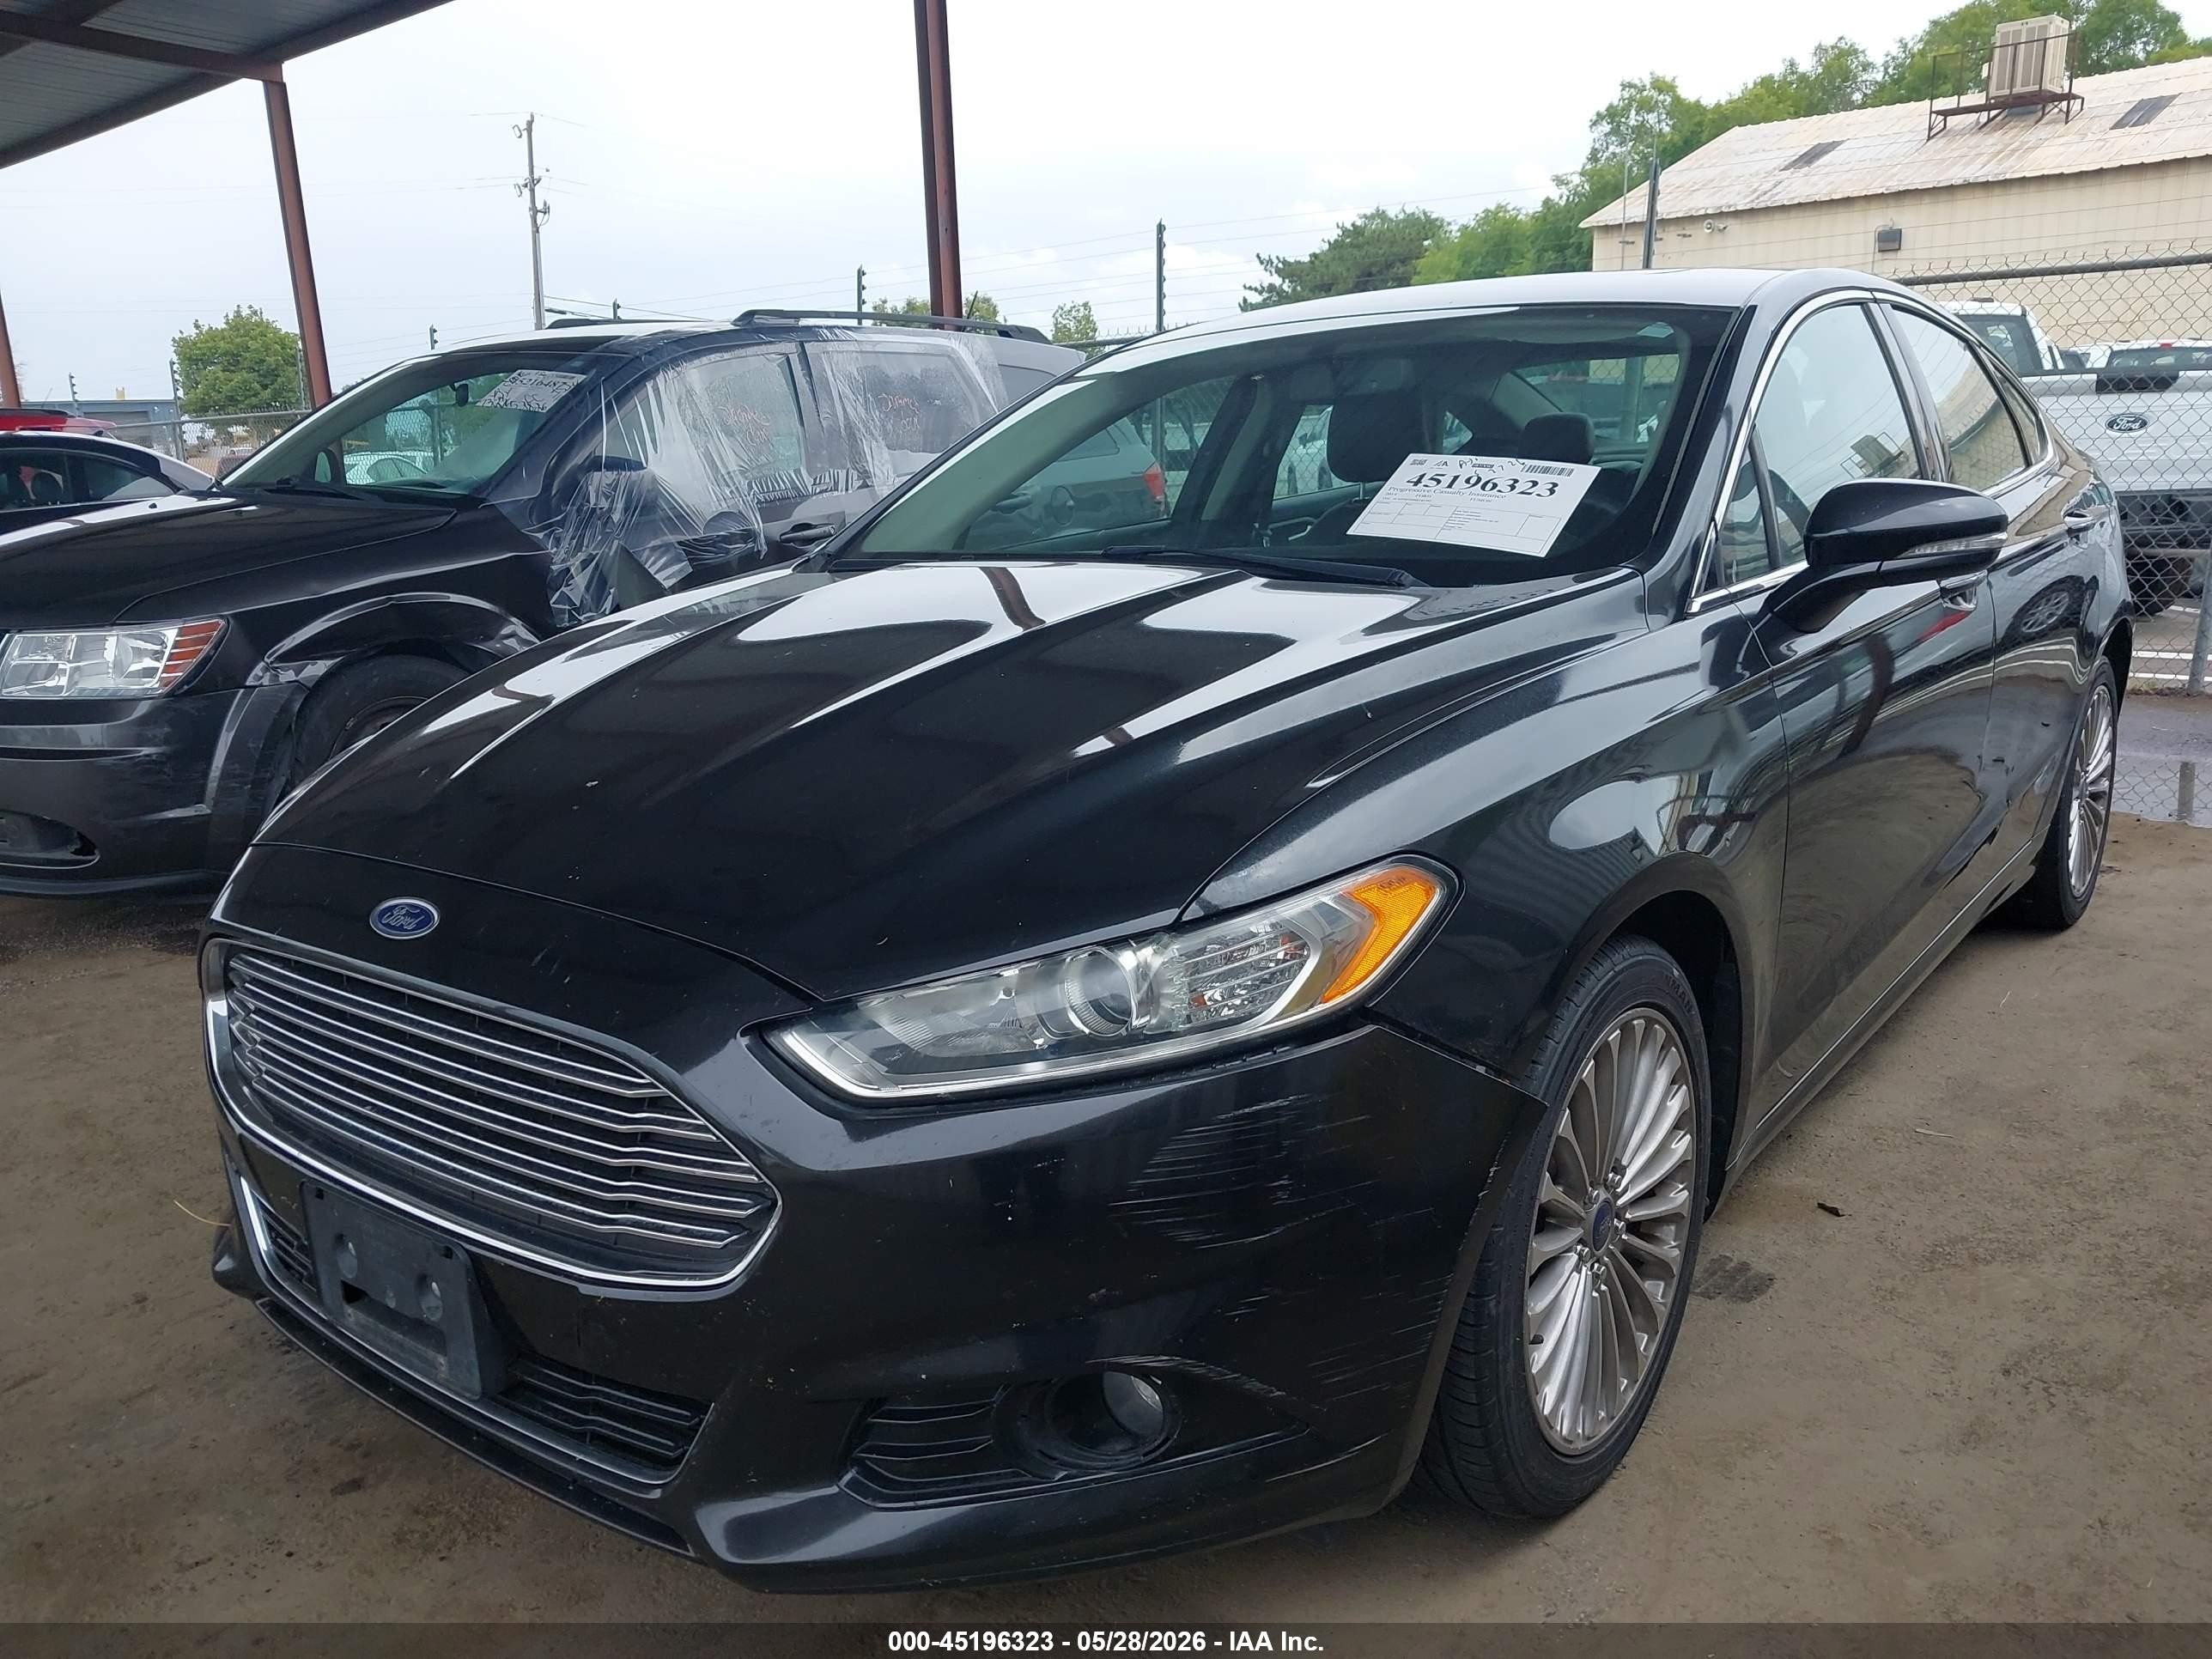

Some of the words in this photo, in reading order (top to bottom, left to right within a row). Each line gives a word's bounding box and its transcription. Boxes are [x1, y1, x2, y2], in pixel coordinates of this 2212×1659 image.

[2113, 416, 2142, 430] Ford
[1406, 472, 1559, 497] 45196323
[381, 905, 426, 930] Ford
